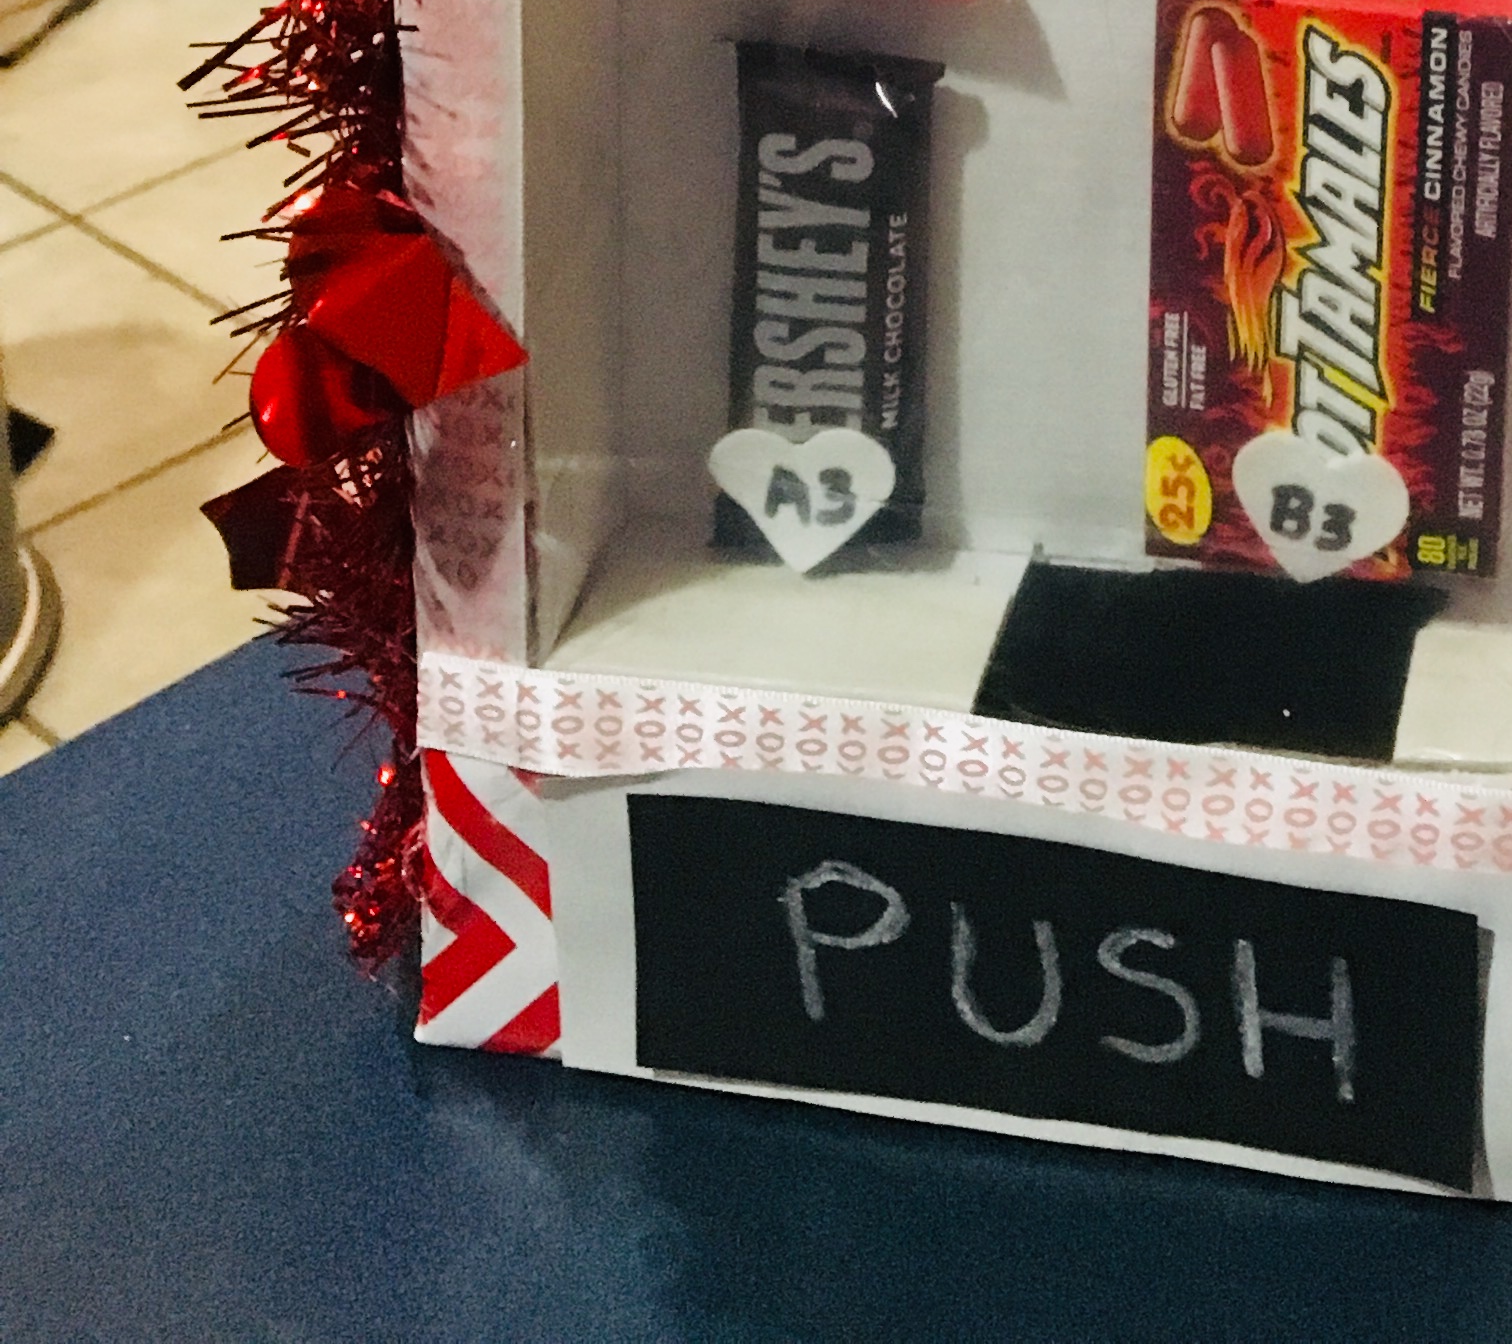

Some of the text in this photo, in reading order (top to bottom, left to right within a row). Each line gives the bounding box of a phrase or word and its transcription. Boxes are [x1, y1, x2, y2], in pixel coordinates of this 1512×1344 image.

[1275, 23, 1394, 404] TAMALES
[1415, 26, 1448, 314] FIERCE CINNAMON
[1448, 30, 1473, 279] FLAVORED CHEWY CANDIES
[1477, 81, 1505, 238] ARTIFICIALLY FLAVORED
[752, 132, 875, 444] ERSHEY'S
[880, 211, 909, 431] MILK CHOCOLATE
[1165, 312, 1181, 348] FREE
[1189, 346, 1206, 410] FAT FREE
[764, 463, 857, 528] A3
[1269, 484, 1355, 552] B3
[1418, 535, 1448, 565] 80
[776, 858, 1357, 1104] PUSH
